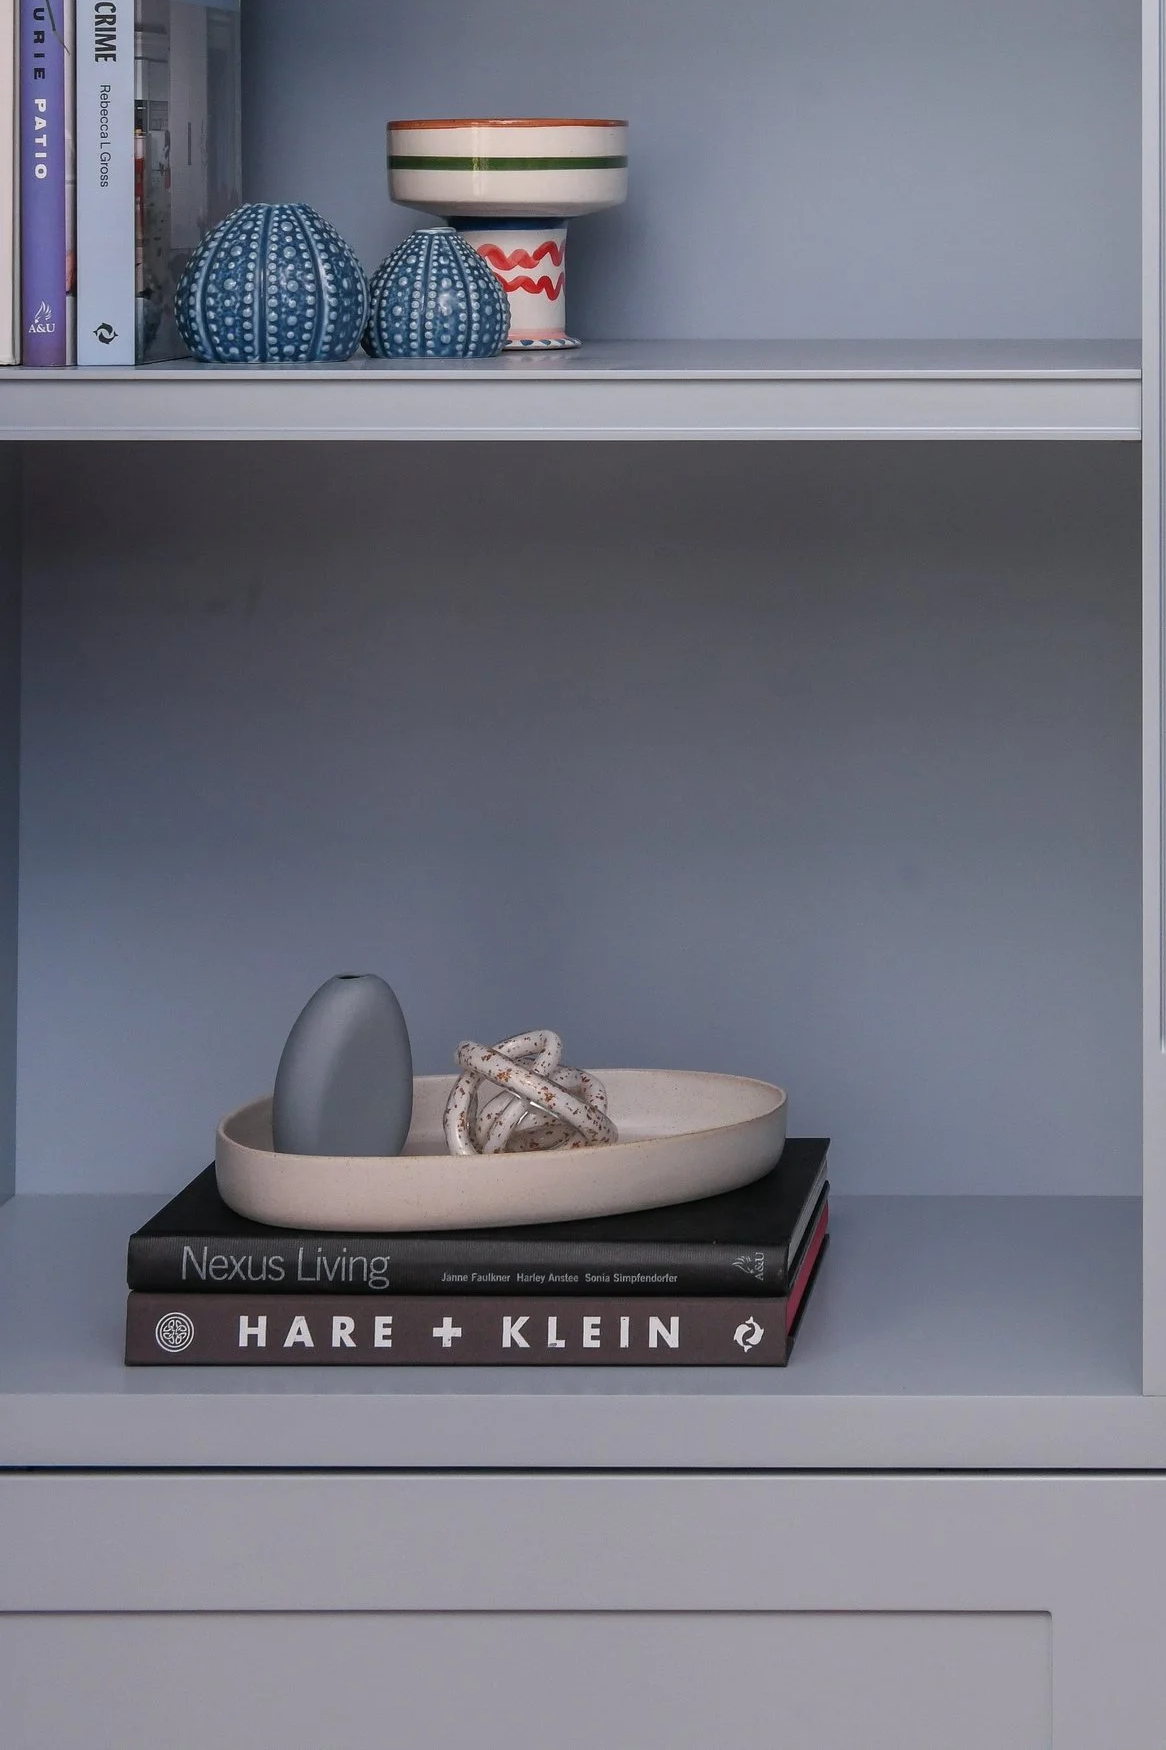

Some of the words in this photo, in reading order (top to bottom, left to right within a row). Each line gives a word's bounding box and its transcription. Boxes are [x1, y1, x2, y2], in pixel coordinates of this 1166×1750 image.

[94, 1, 117, 63] CRIME
[100, 84, 111, 139] Rebecca
[34, 98, 47, 179] PATIO
[100, 152, 111, 188] Gross
[28, 323, 56, 333] A&U
[181, 1245, 285, 1281] Nexus
[297, 1246, 391, 1289] Living
[441, 1272, 469, 1282] Janne
[471, 1272, 511, 1283] Faulkner
[516, 1272, 546, 1285] Harley
[548, 1272, 579, 1283] Anstee
[585, 1273, 611, 1283] Sonia
[613, 1273, 678, 1285] Simpfendorfer
[754, 1251, 764, 1281] A&U
[238, 1315, 393, 1348] HARE
[432, 1316, 462, 1348] +
[502, 1316, 680, 1348] KLEIN
